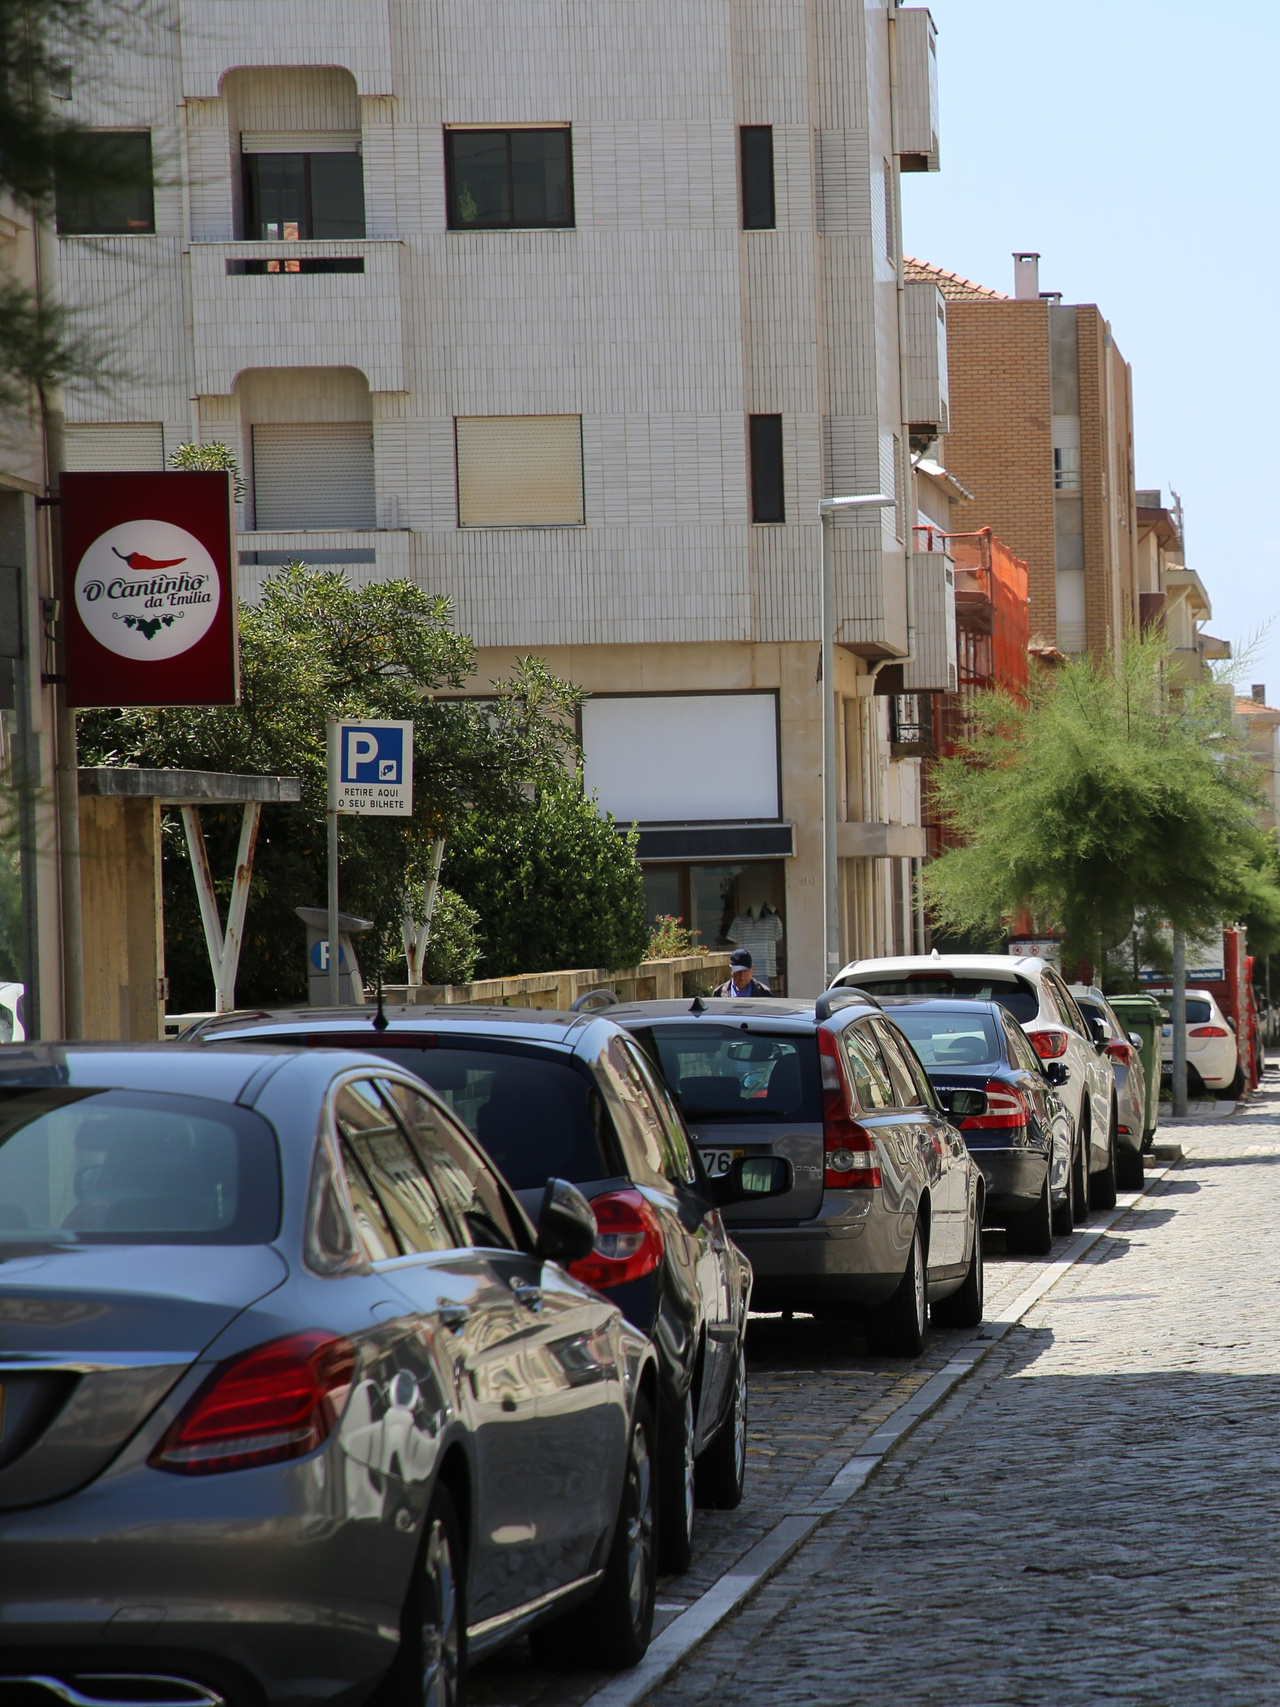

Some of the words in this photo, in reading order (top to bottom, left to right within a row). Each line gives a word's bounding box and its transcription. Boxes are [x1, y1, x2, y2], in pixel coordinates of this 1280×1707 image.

[83, 581, 104, 602] O
[107, 574, 205, 600] Cantinho
[144, 596, 164, 609] da
[347, 731, 379, 780] P
[344, 788, 374, 797] RETIRE
[377, 789, 399, 797] AQUI
[338, 799, 345, 807] O
[349, 799, 366, 808] SEU
[370, 800, 404, 809] BILHETE
[703, 1151, 731, 1174] 76
